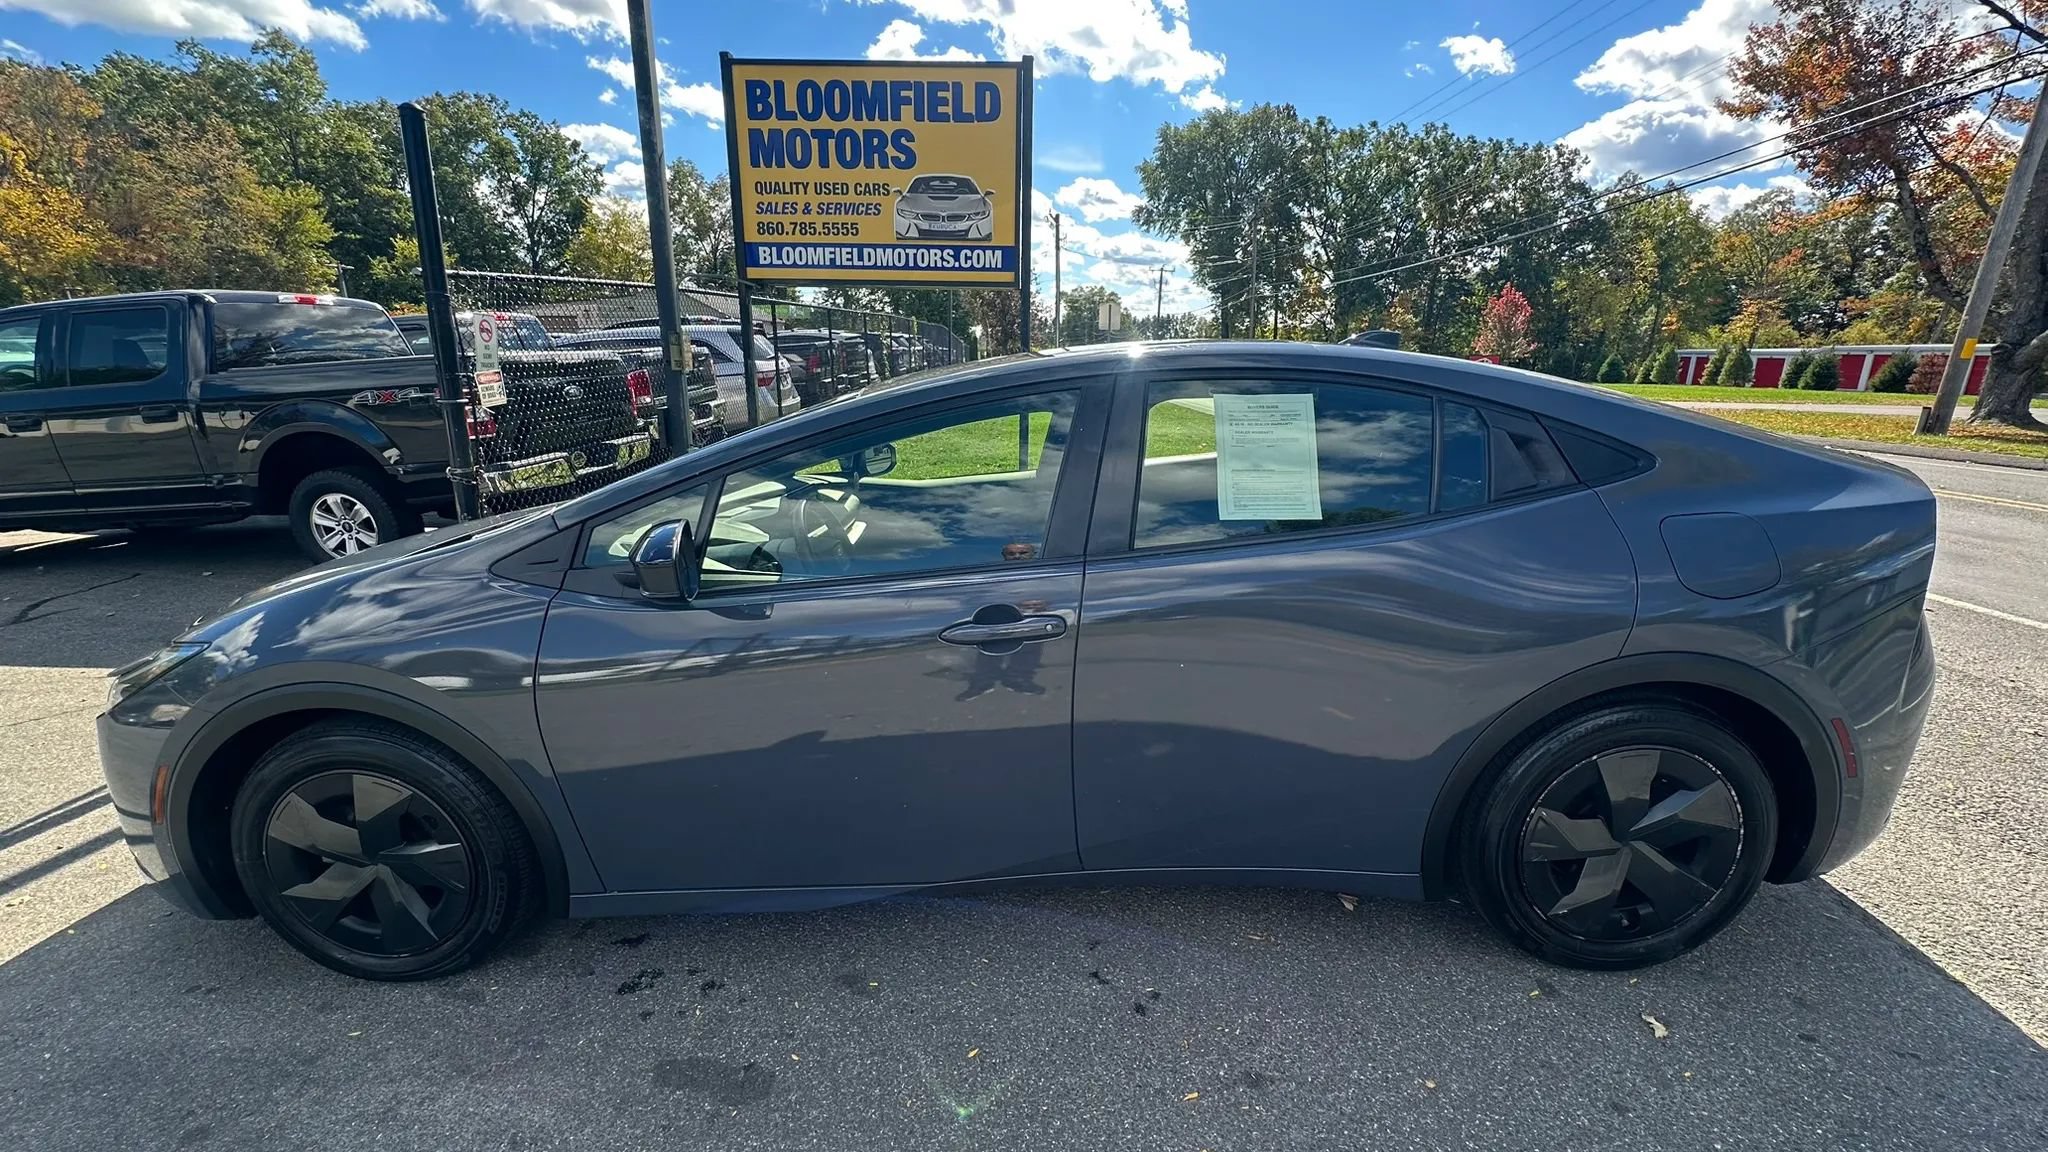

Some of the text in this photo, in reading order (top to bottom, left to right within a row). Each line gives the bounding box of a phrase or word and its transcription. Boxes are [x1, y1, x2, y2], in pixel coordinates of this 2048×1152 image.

[744, 79, 1002, 123] BLOOMFIELD
[748, 128, 917, 170] MOTORS
[754, 181, 890, 197] QUALITY USED CARS
[755, 201, 882, 216] SALES & SERVICES
[756, 221, 860, 237] 860.785.5555
[758, 246, 1002, 269] BLOOMFIELDMOTORS.COM
